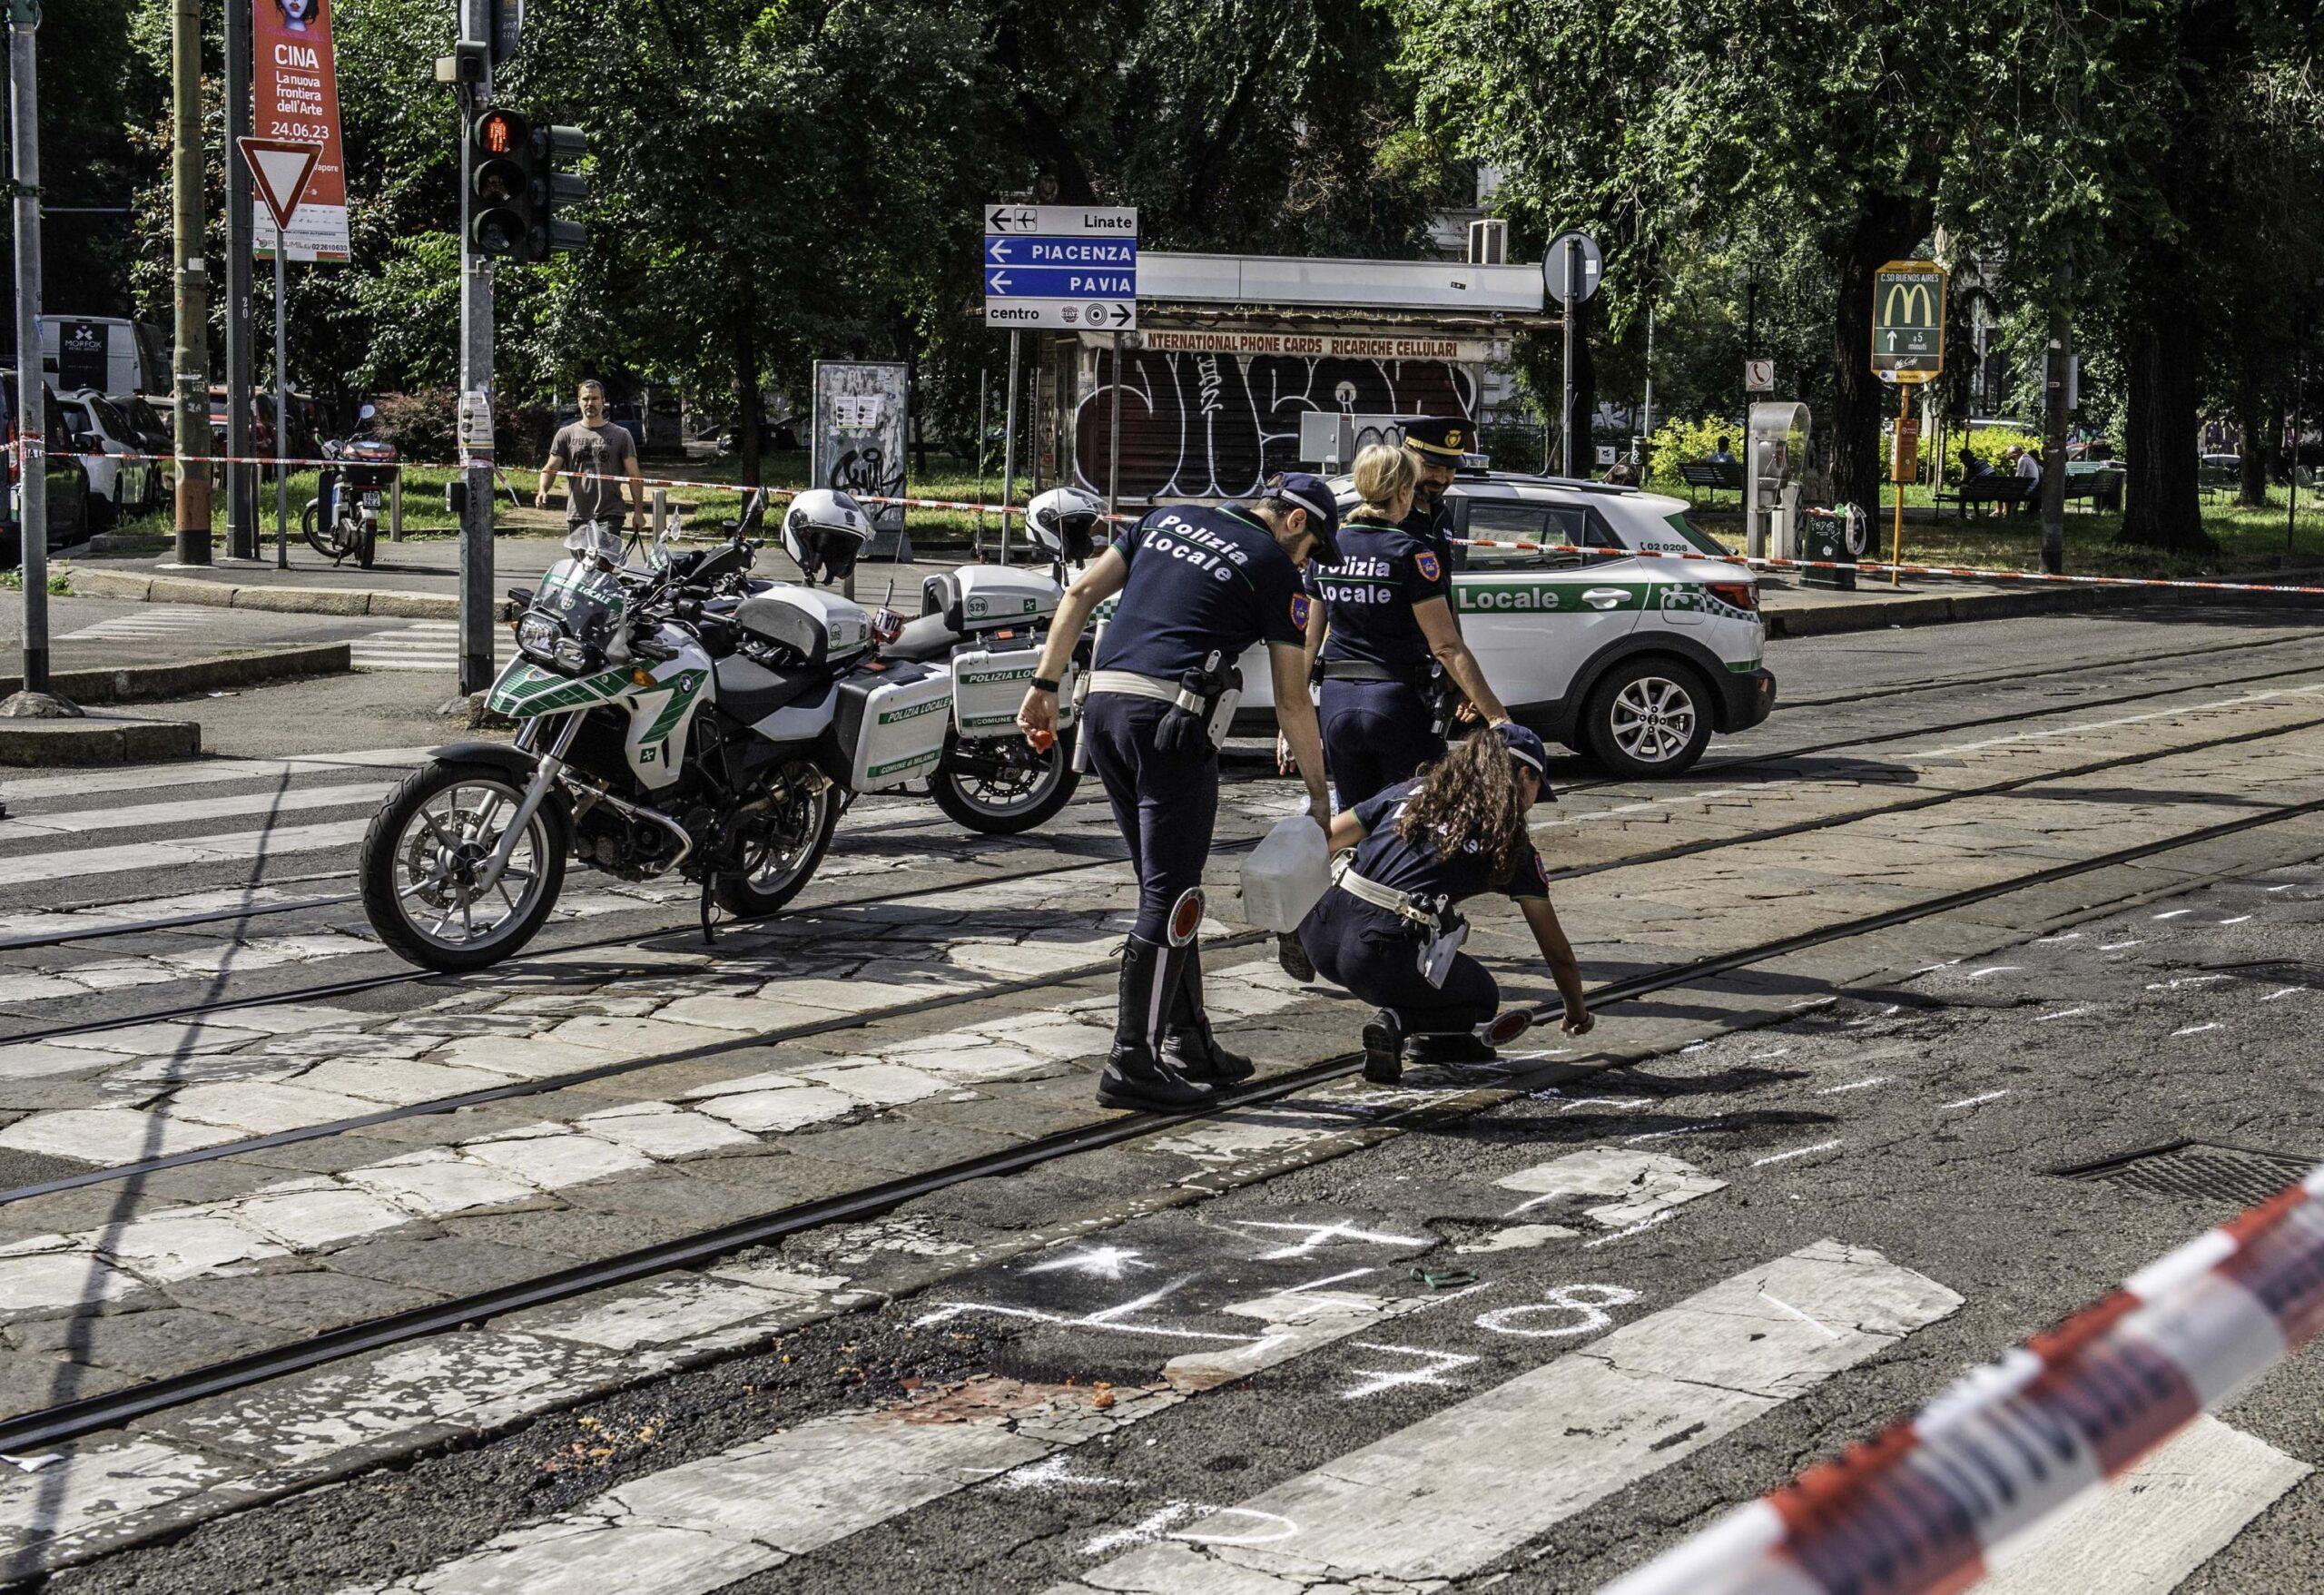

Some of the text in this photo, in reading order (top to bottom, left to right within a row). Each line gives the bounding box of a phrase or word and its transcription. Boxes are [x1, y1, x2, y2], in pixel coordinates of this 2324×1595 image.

[274, 44, 320, 69] CINA
[276, 71, 320, 88] La nuova
[277, 84, 321, 101] frontiera
[277, 99, 323, 116] dell'Arte
[271, 121, 330, 139] 24.06.23
[1084, 214, 1132, 228] Linate
[1031, 244, 1132, 261] PIACENZA
[1069, 277, 1131, 291] PAVIA
[1896, 273, 1920, 282] BUENOS
[1921, 273, 1939, 282] AIRES
[990, 308, 1039, 320] centro
[64, 340, 102, 348] MORFOX
[1917, 331, 1924, 342] 5
[1239, 334, 1280, 352] PHONE
[1284, 336, 1322, 353] CARDS
[1331, 339, 1393, 356] RICARICHE
[1396, 340, 1457, 357] CELLULARI
[1157, 515, 1249, 566] Polizia
[1647, 543, 1689, 552] 02 0208
[1143, 530, 1232, 581] Locale
[577, 586, 612, 605] LOCALE
[1318, 581, 1392, 604] Locale
[1458, 586, 1560, 609] Locale
[970, 603, 986, 612] 529
[969, 669, 1037, 683] POLIZIA LOC
[888, 697, 949, 723] POLIZIA LOCALE
[977, 715, 1011, 724] COMUNE
[881, 763, 906, 774] COMUNE
[913, 753, 935, 765] MILANO
[1474, 1283, 1643, 1337] 8
